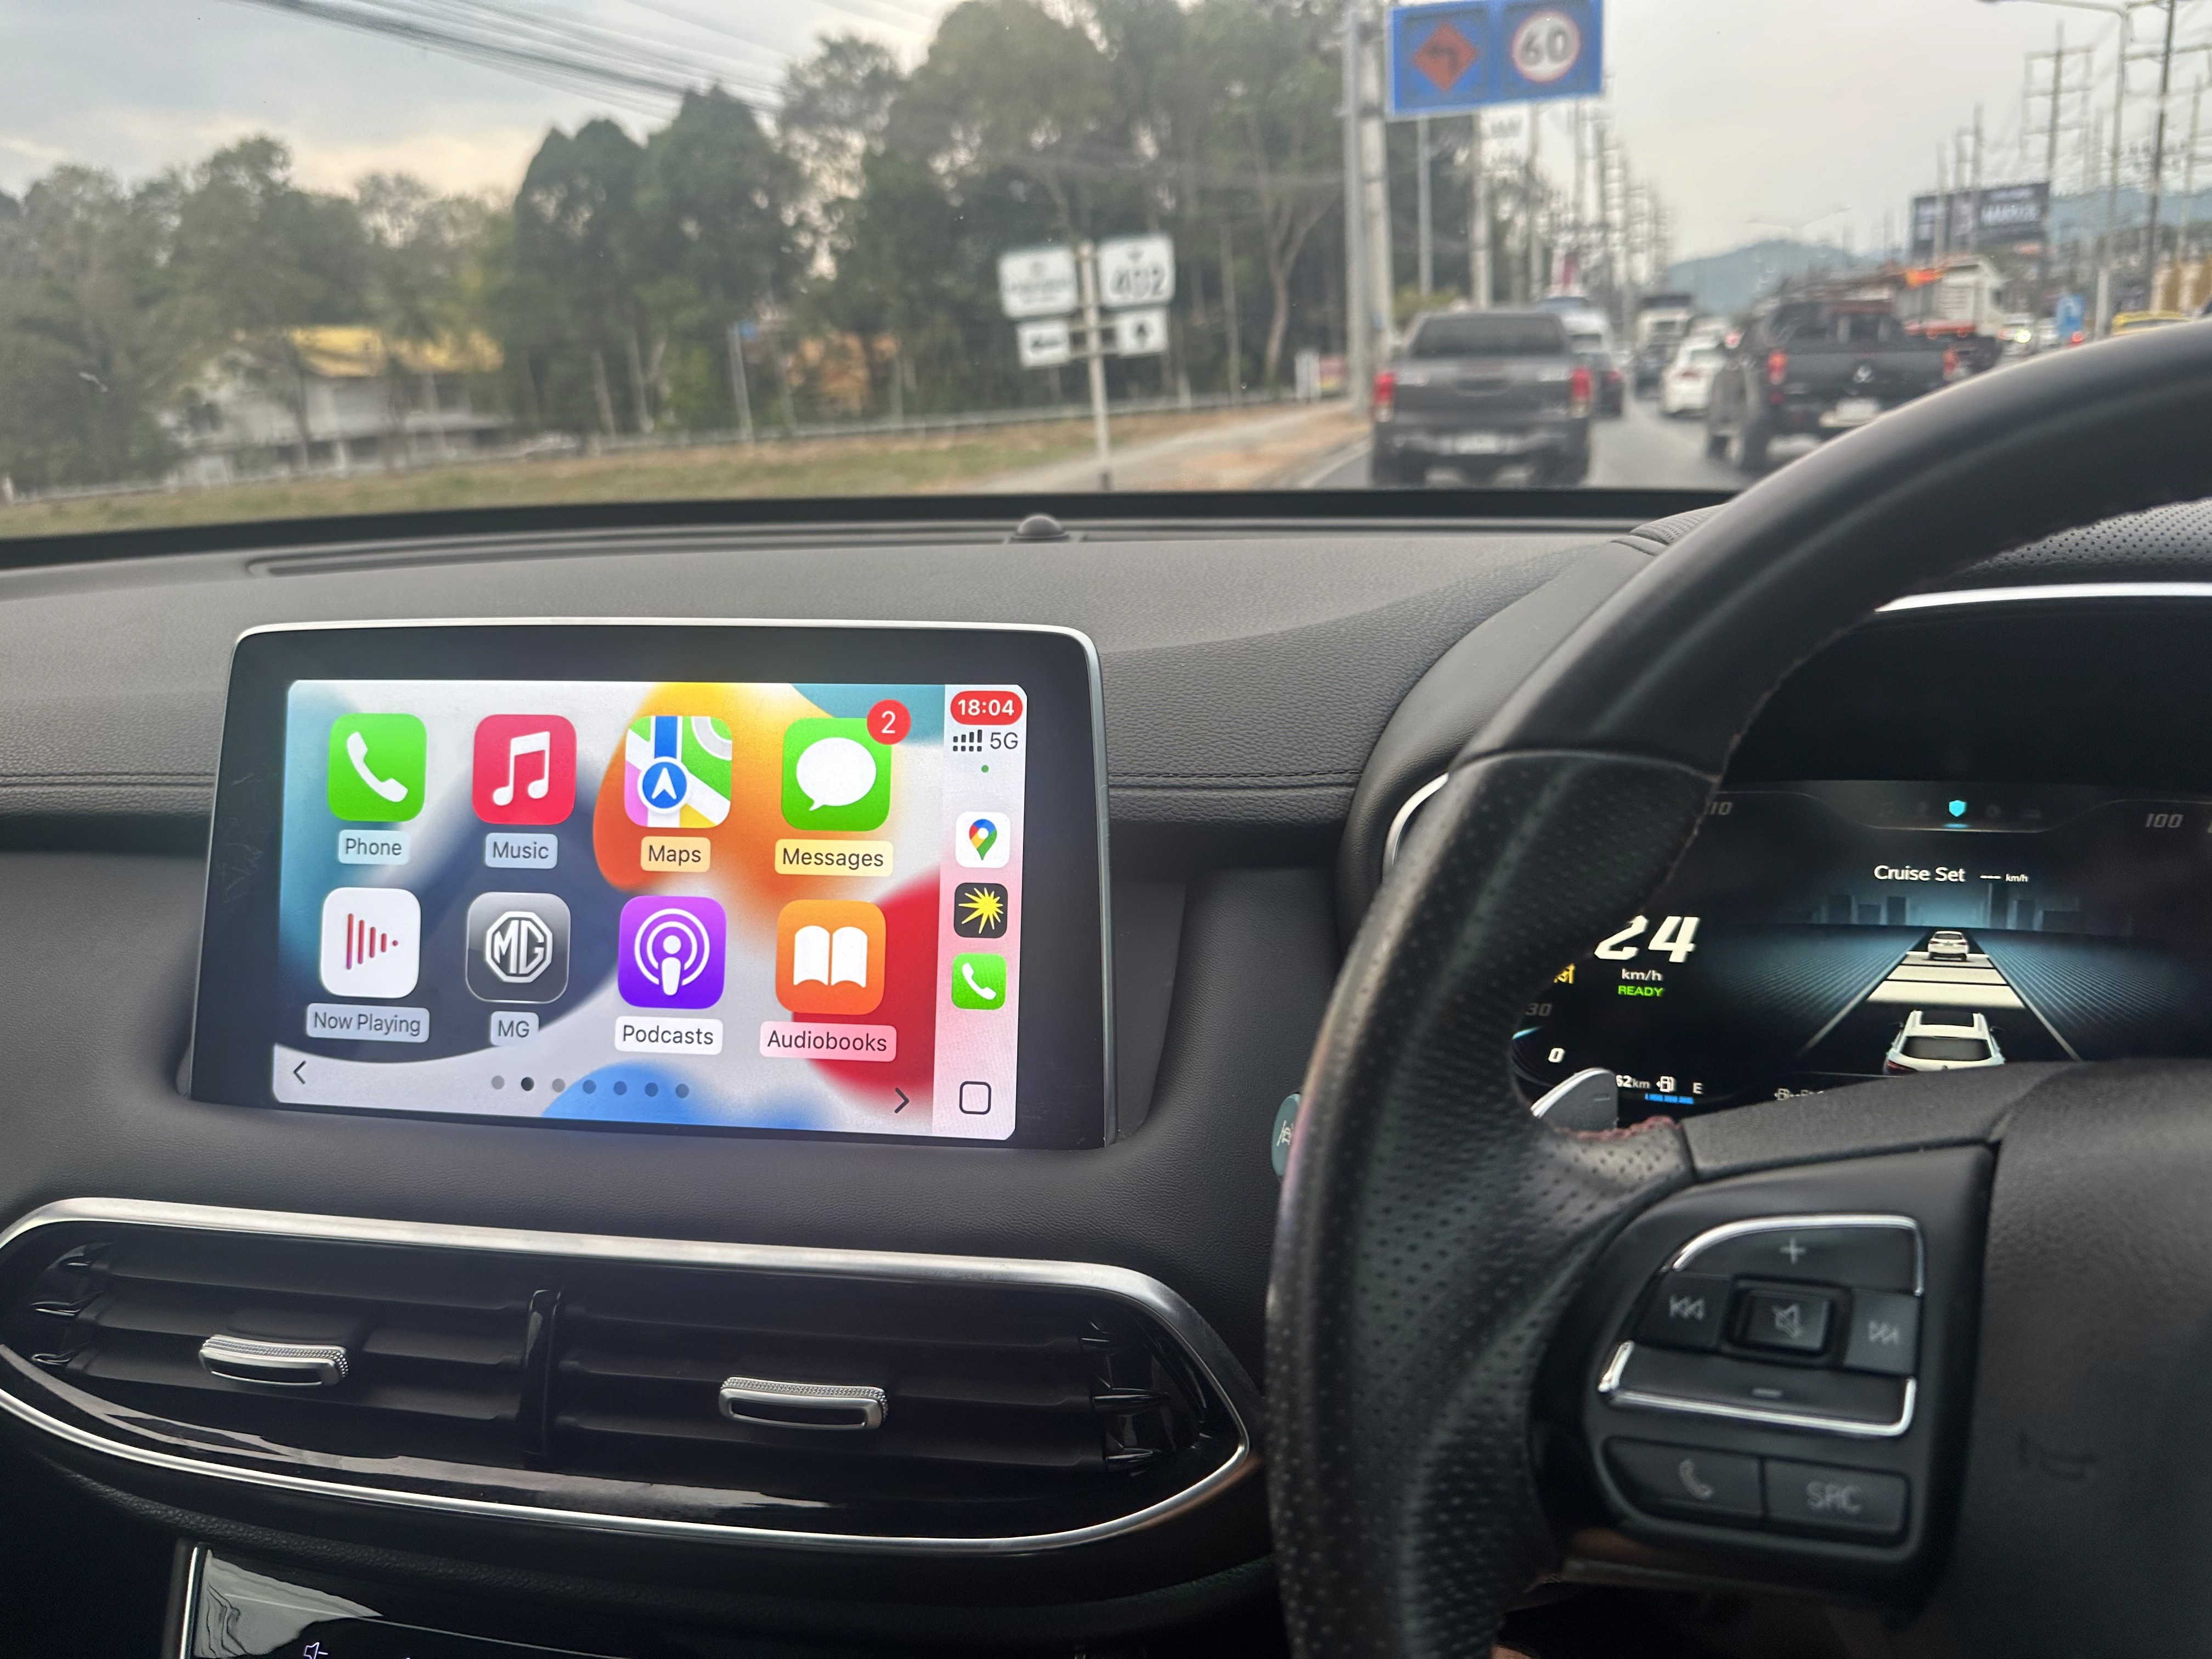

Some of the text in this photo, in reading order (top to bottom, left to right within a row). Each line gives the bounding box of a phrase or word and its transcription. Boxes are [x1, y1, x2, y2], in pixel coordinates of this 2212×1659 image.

[1521, 25, 1570, 67] 60
[958, 699, 1014, 716] 18:04
[882, 711, 896, 734] 2
[990, 732, 1018, 749] 5G
[2145, 813, 2183, 828] 100
[345, 838, 402, 856] Phone
[493, 840, 549, 859] Music
[648, 845, 702, 867] Maps
[782, 848, 884, 871] Messages
[1874, 865, 1931, 881] Cruise
[1934, 866, 1966, 882] Set
[2005, 874, 2029, 882] km/h
[493, 919, 545, 975] MG
[1594, 915, 1700, 963] 24
[1621, 968, 1663, 981] km/h
[1618, 985, 1665, 997] READY
[1526, 1003, 1552, 1016] 30
[313, 1012, 421, 1036] Now Playing
[498, 1020, 530, 1037] MG
[623, 1025, 714, 1046] Podcasts
[767, 1030, 887, 1052] Audiobooks
[1548, 1048, 1566, 1063] 0
[1692, 1082, 1703, 1094] E
[1807, 1482, 1861, 1514] SRC
